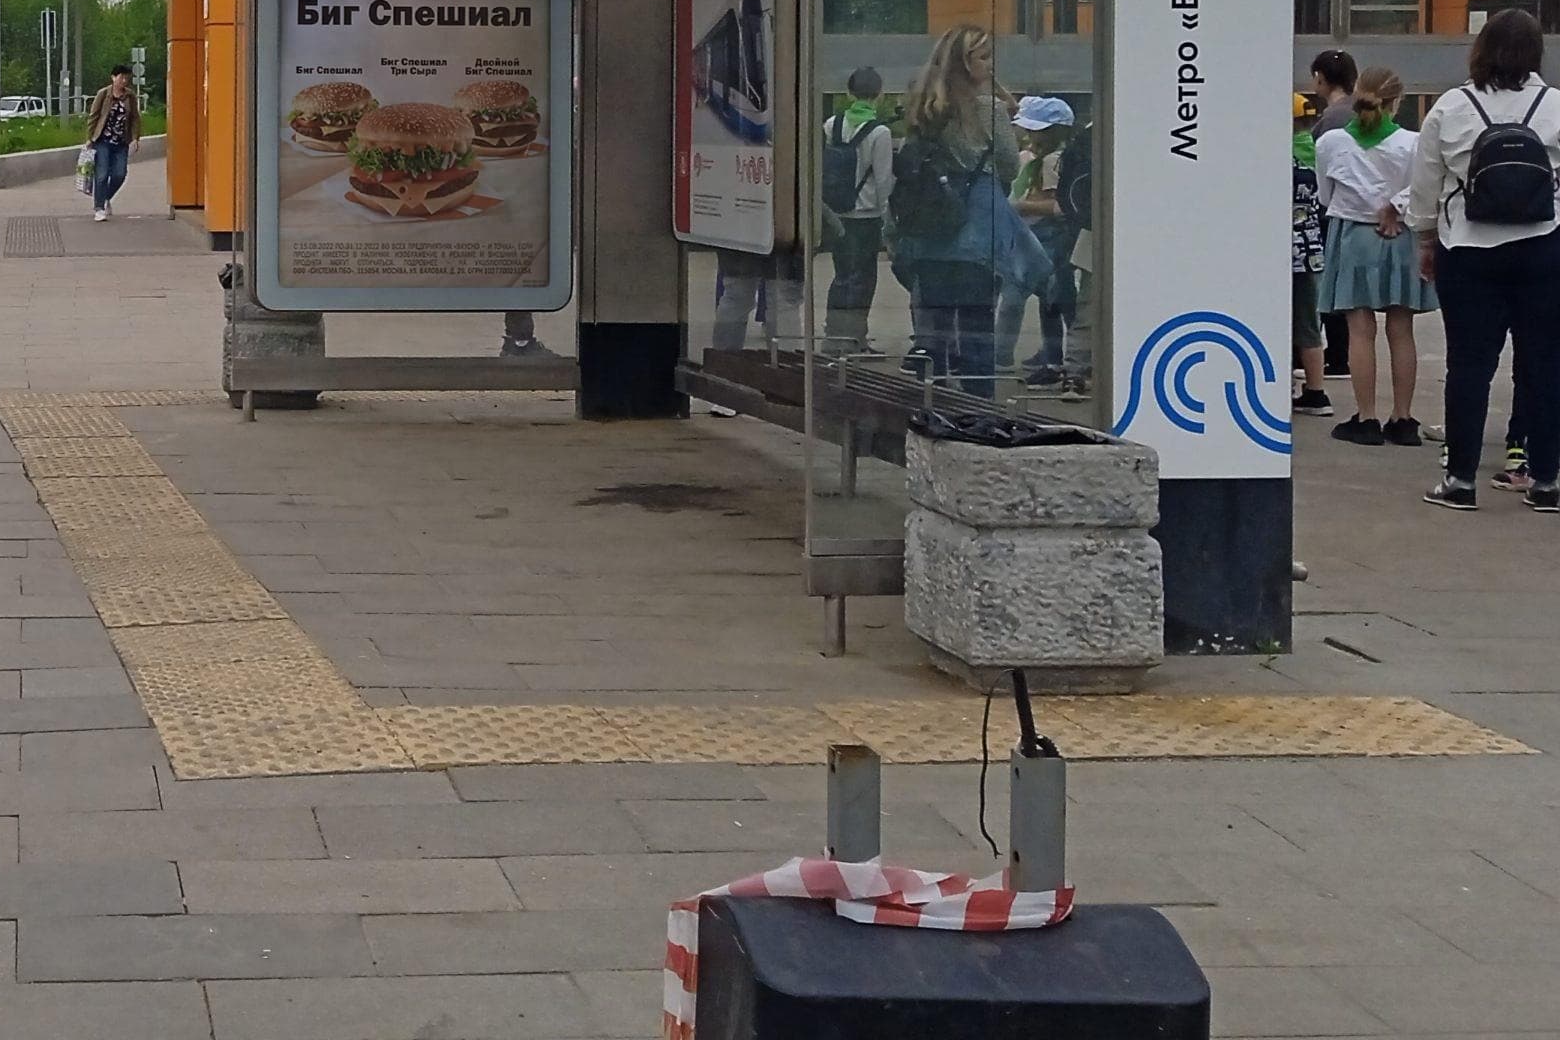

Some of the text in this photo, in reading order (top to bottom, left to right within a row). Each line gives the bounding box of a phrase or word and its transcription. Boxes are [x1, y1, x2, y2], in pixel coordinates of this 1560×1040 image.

[297, 0, 531, 26] Биг Спешиал
[381, 58, 447, 67] Биг Спешиал
[475, 58, 520, 67] Двойной
[296, 66, 363, 75] Биг Спешиал
[390, 67, 437, 76] Три Сыра
[465, 67, 532, 76] Биг Спешиал
[1170, 41, 1205, 160] Метро
